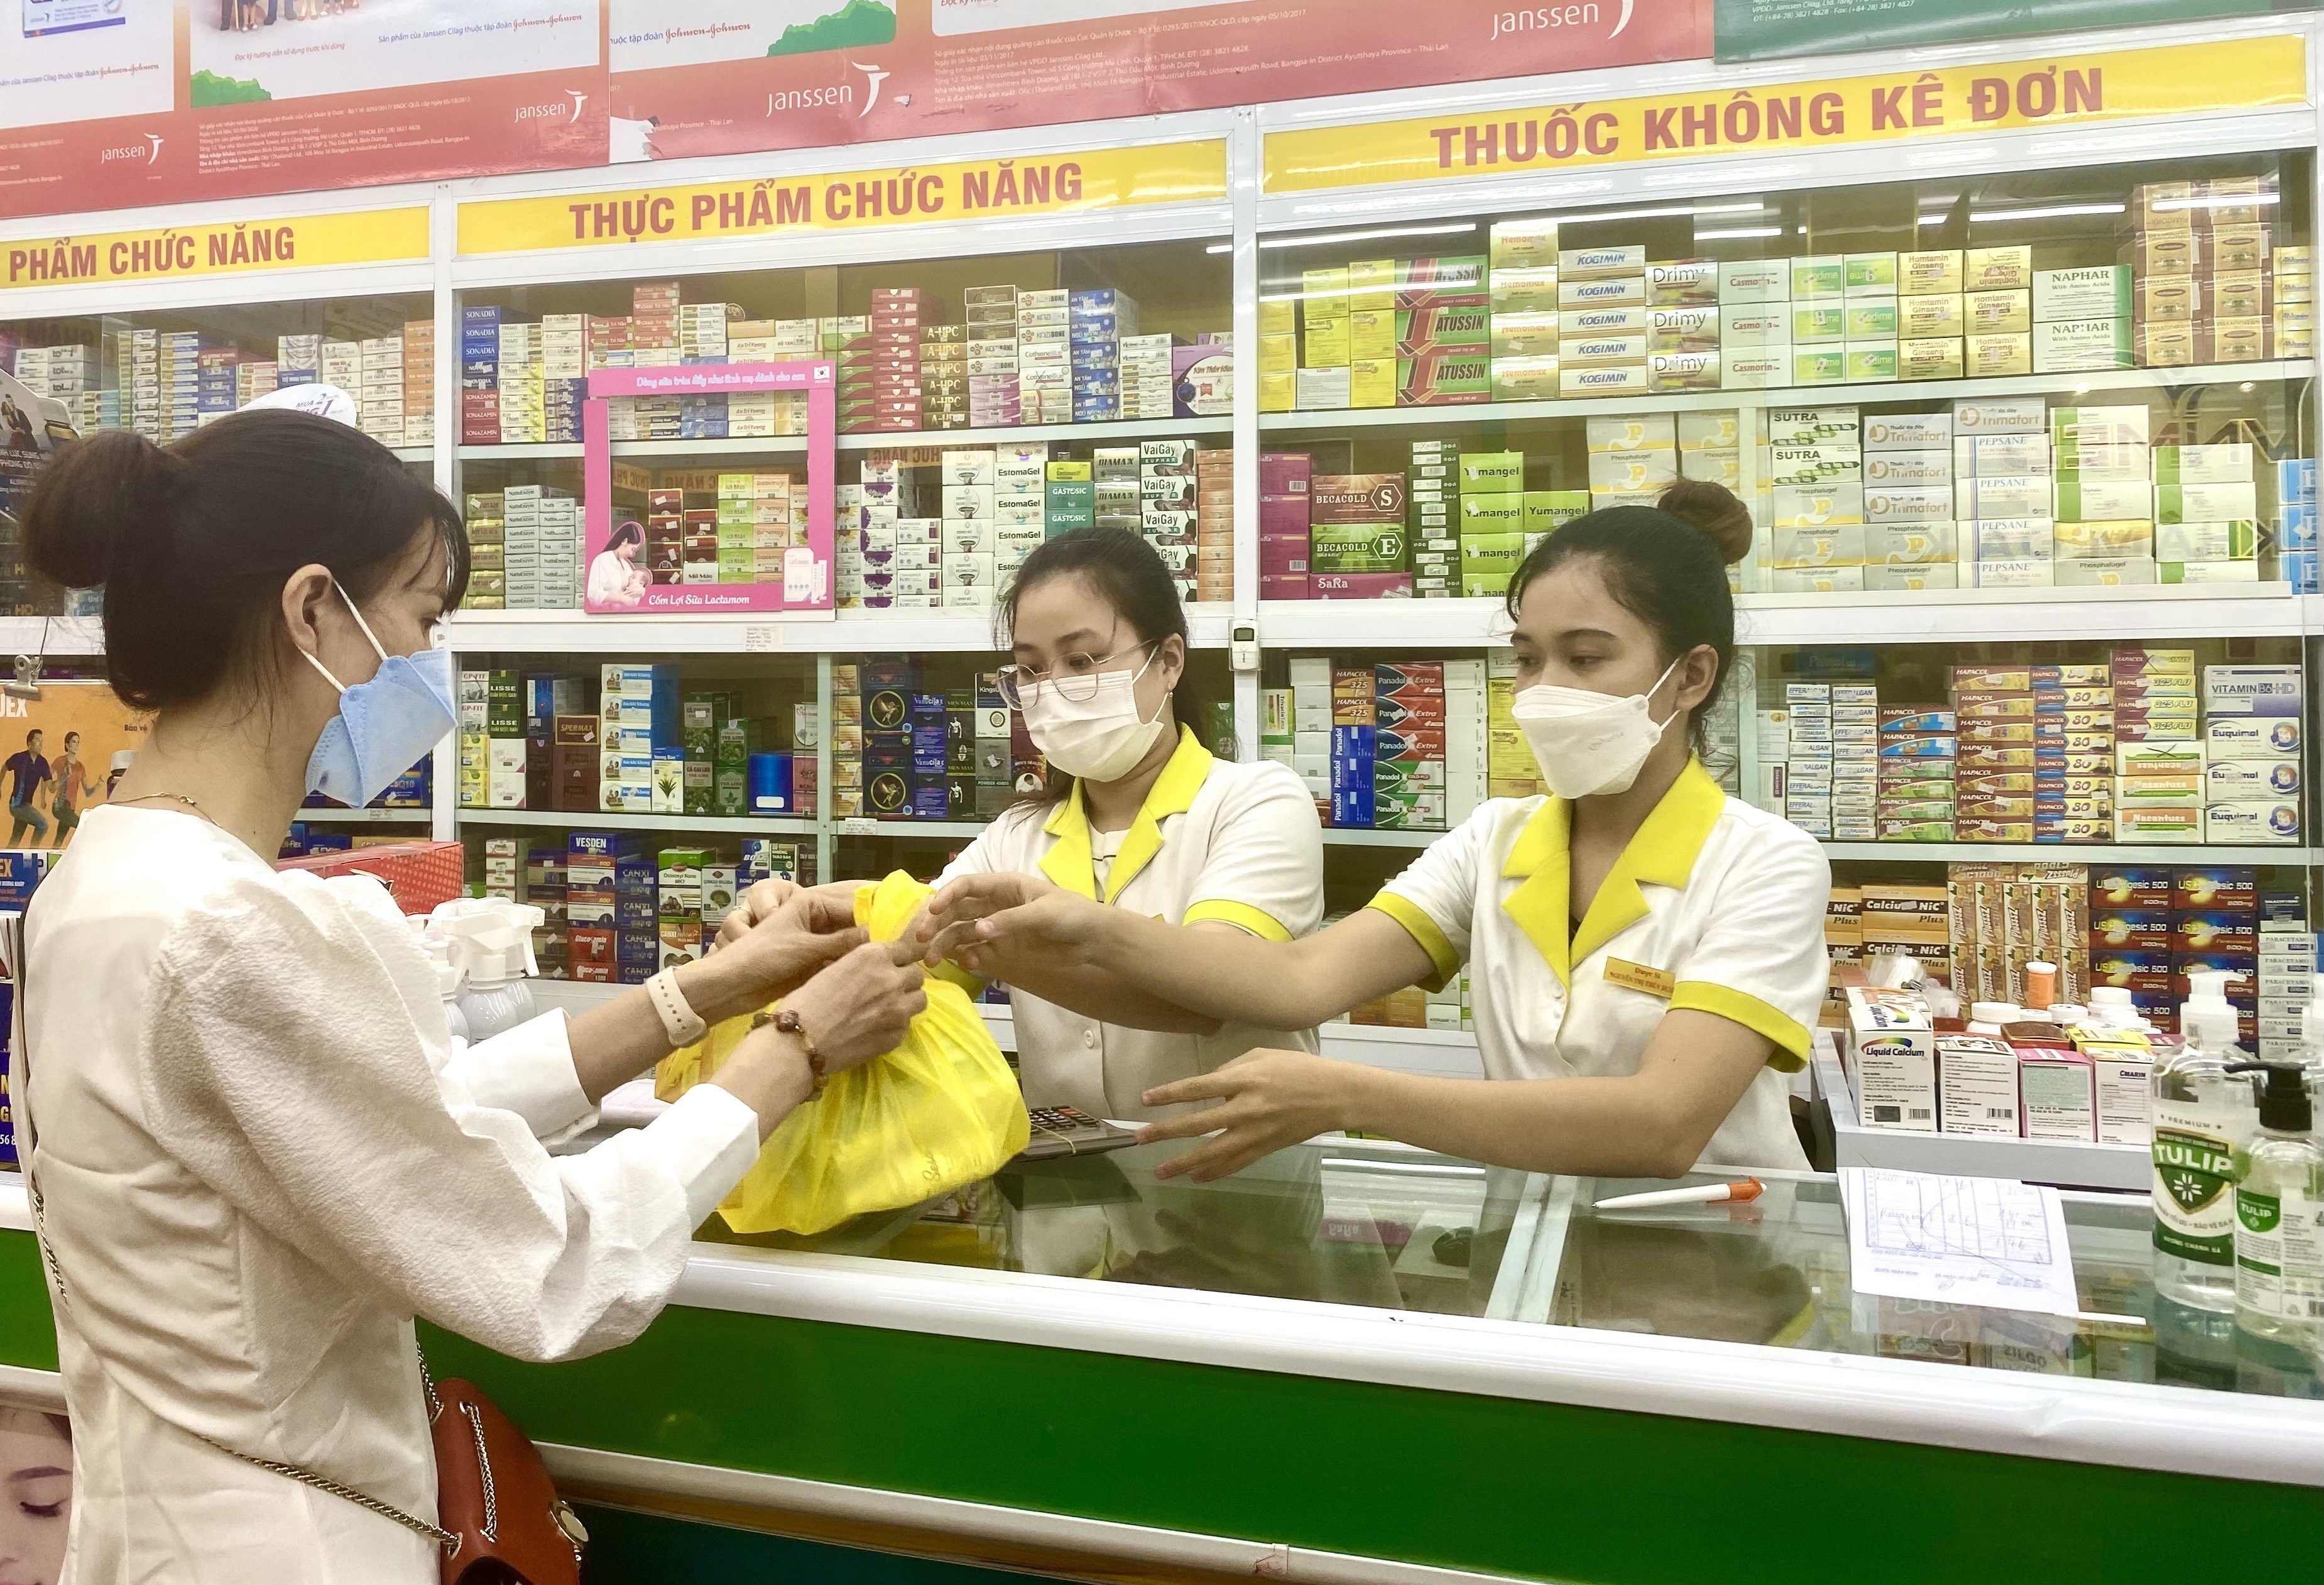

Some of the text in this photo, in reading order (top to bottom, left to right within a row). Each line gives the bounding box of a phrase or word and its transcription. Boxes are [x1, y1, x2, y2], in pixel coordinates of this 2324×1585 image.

[422, 28, 446, 39] Janssen
[1430, 65, 2103, 168] THUỐC KHÔNG KÊ ĐƠN
[569, 161, 1083, 243] THỰC PHẨM CHỨC NĂNG
[9, 224, 295, 282] PHẨM CHỨC NĂNG
[1578, 253, 1625, 265] KOGIMIN
[1909, 255, 1948, 263] Homtamin
[2053, 270, 2109, 282] NAPHAR
[1578, 285, 1625, 297] KOGIMIN
[1909, 298, 1949, 307] Homtamin
[466, 310, 495, 318] SONADIA
[1435, 315, 1484, 332] ATUSSIN
[1578, 314, 1626, 326] KOGIMIN
[1654, 312, 1706, 329] Drimy
[1976, 337, 2017, 346] Homtamin
[1733, 363, 1772, 372] Casmorin
[1774, 413, 1819, 422] SUTRA
[1979, 437, 2027, 446] PEPSANE
[1776, 451, 1821, 460] SUTRA
[1099, 458, 1134, 466] DIAMAX
[998, 468, 1040, 476] EstomaGel
[1464, 466, 1519, 478] Ymangel
[1980, 479, 2029, 488] PEPSANE
[1052, 487, 1086, 495] GASTOSIC
[1099, 492, 1134, 500] DIAMAX
[1316, 489, 1392, 507] BECACOLD S
[998, 500, 1040, 508] EstomaGel
[1529, 506, 1585, 518] Yumangel
[1316, 538, 1395, 555] BECACOLD E
[1318, 578, 1348, 588] SaRa
[648, 594, 668, 606] Cốm
[705, 594, 750, 605] Lactamom
[2212, 685, 2257, 694] VITAMIN
[2073, 692, 2092, 702] 80
[2073, 781, 2092, 791] 80
[576, 837, 607, 848] VESDEN
[623, 869, 650, 878] CANXI
[2152, 881, 2168, 889] 500
[2237, 882, 2253, 890] 500
[1833, 916, 1858, 926] Plus
[1919, 915, 1945, 924] Plus
[625, 967, 652, 976] CANXI
[1866, 1048, 1924, 1056] Liquid Calcium
[2168, 1116, 2210, 1129] PREMIUM
[2155, 1144, 2232, 1172] TULIP
[2240, 1203, 2272, 1217] TULIP
